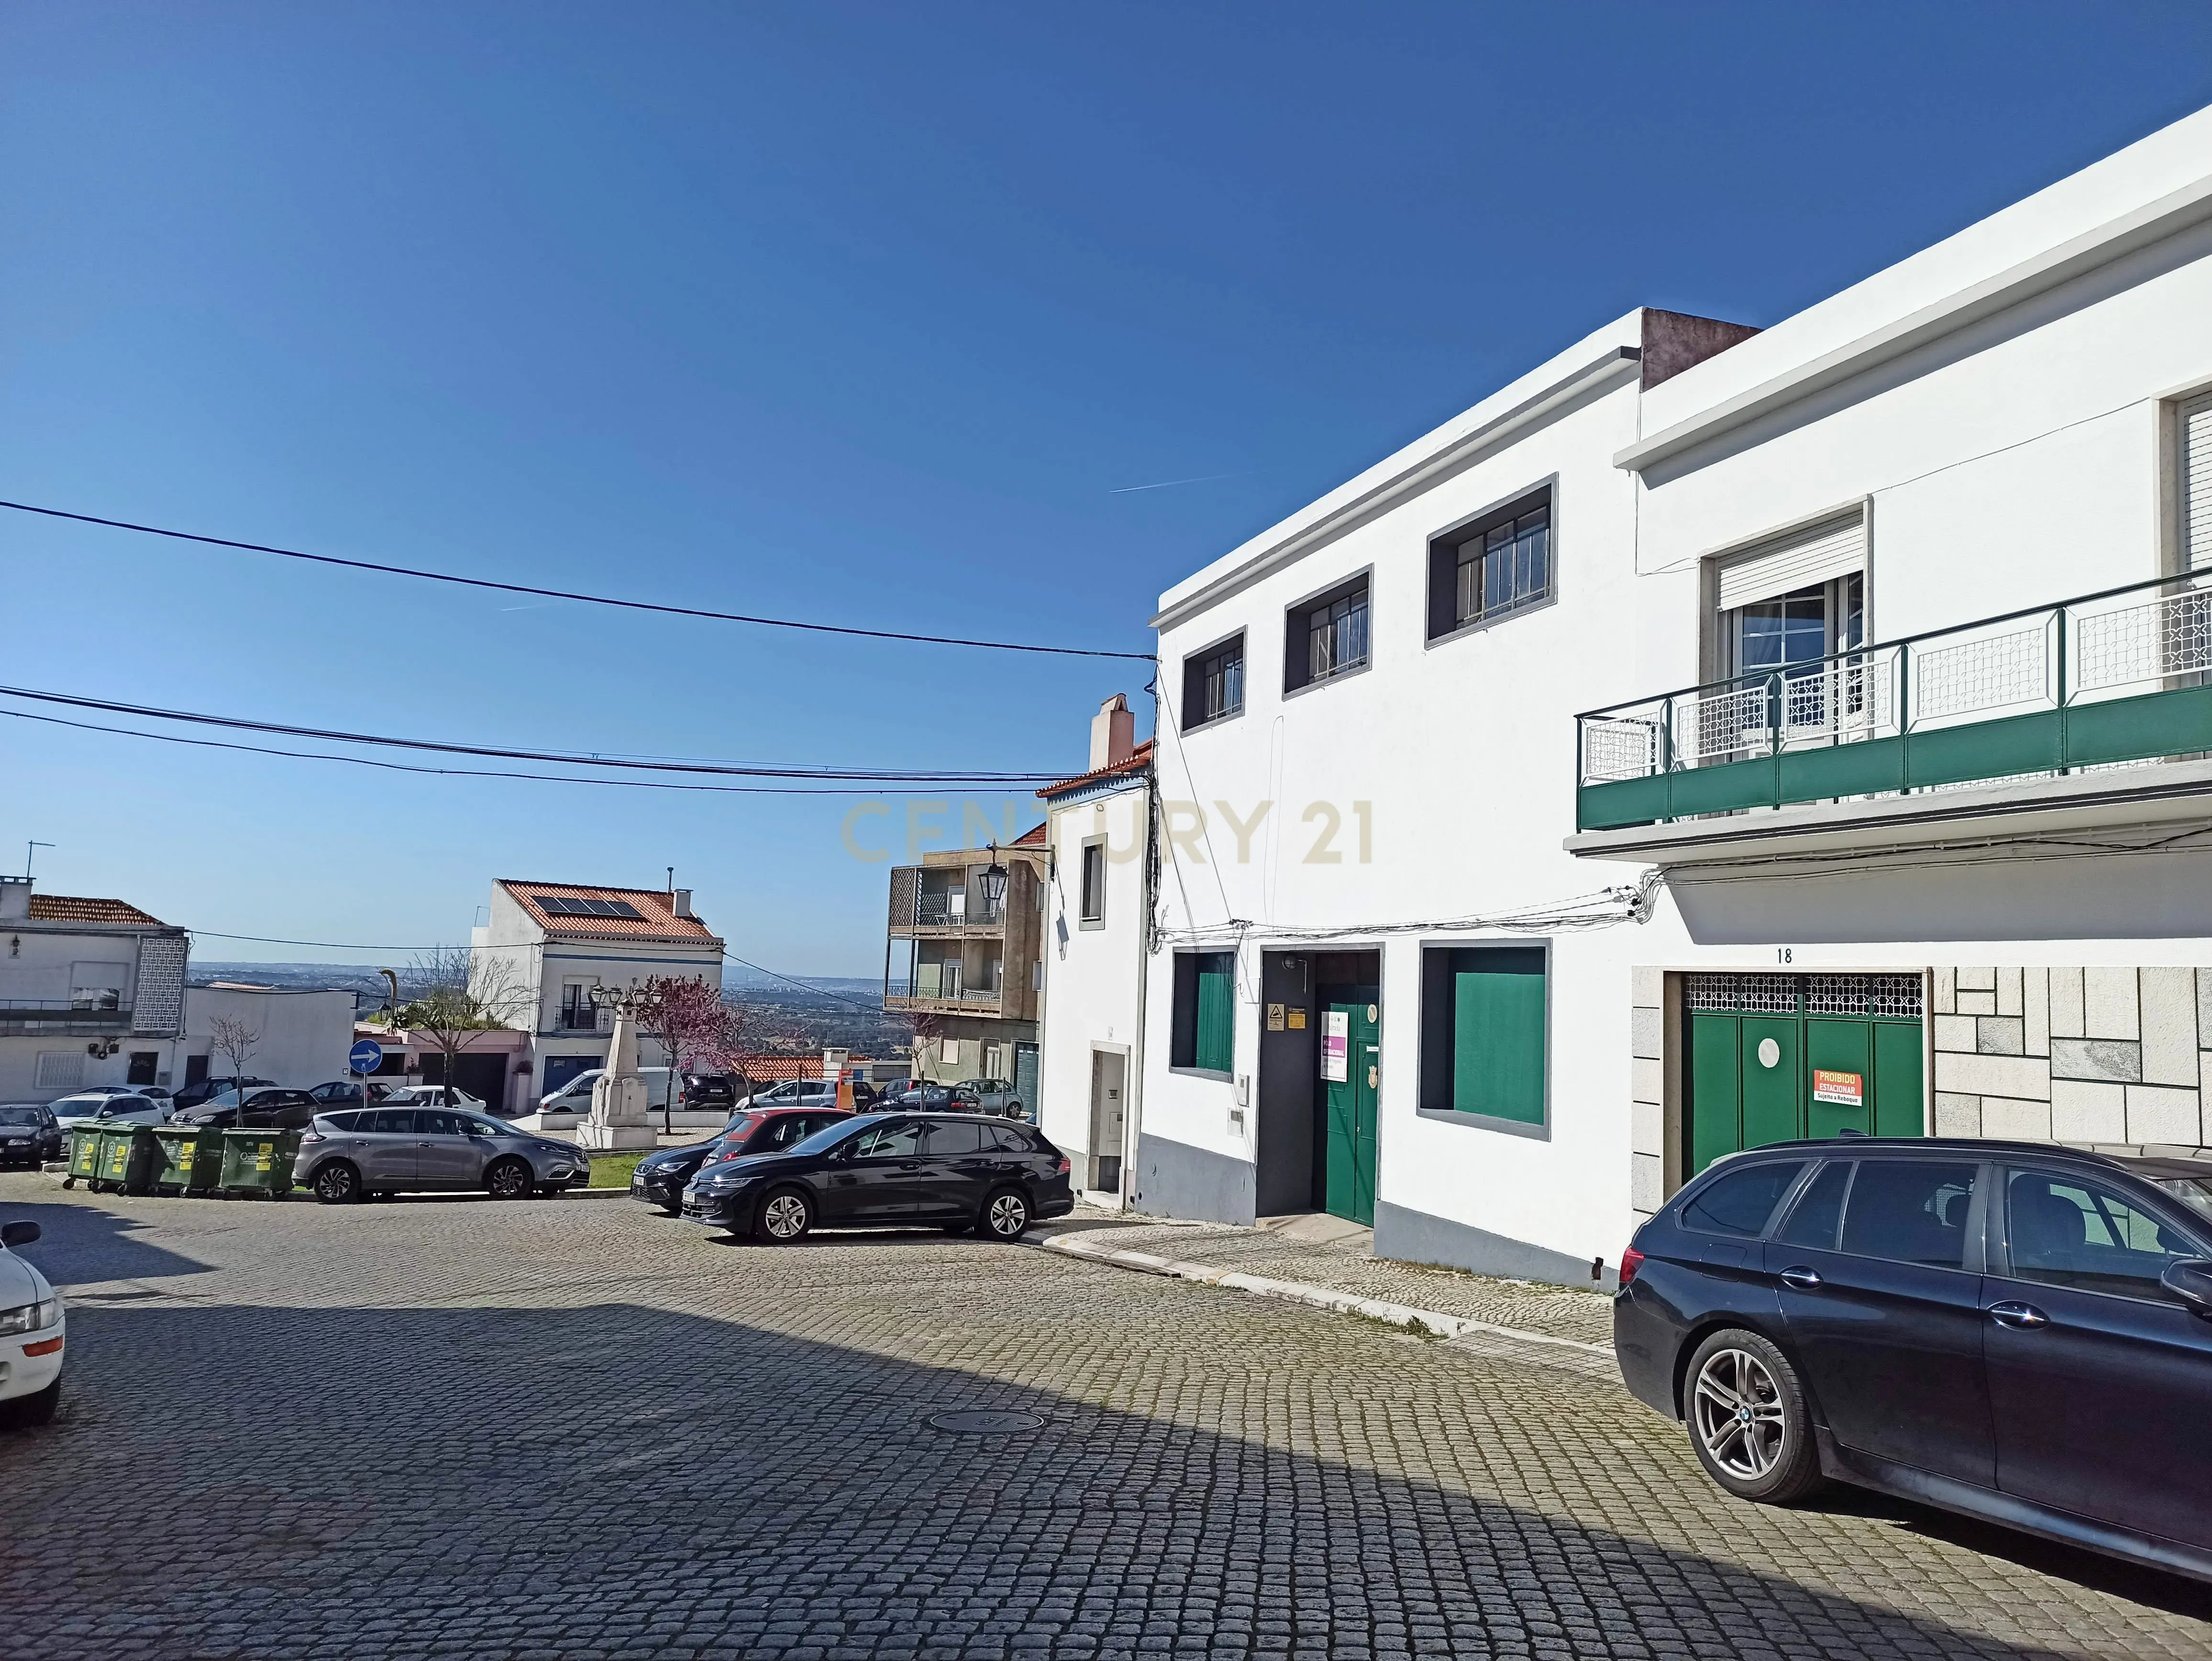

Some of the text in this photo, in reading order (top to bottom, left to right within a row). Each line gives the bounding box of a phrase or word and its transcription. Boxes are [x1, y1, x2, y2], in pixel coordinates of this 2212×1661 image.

[1778, 948, 1792, 963] 18
[1820, 1071, 1855, 1084] PROIBIDO
[1819, 1083, 1855, 1095] ESTACIONAR
